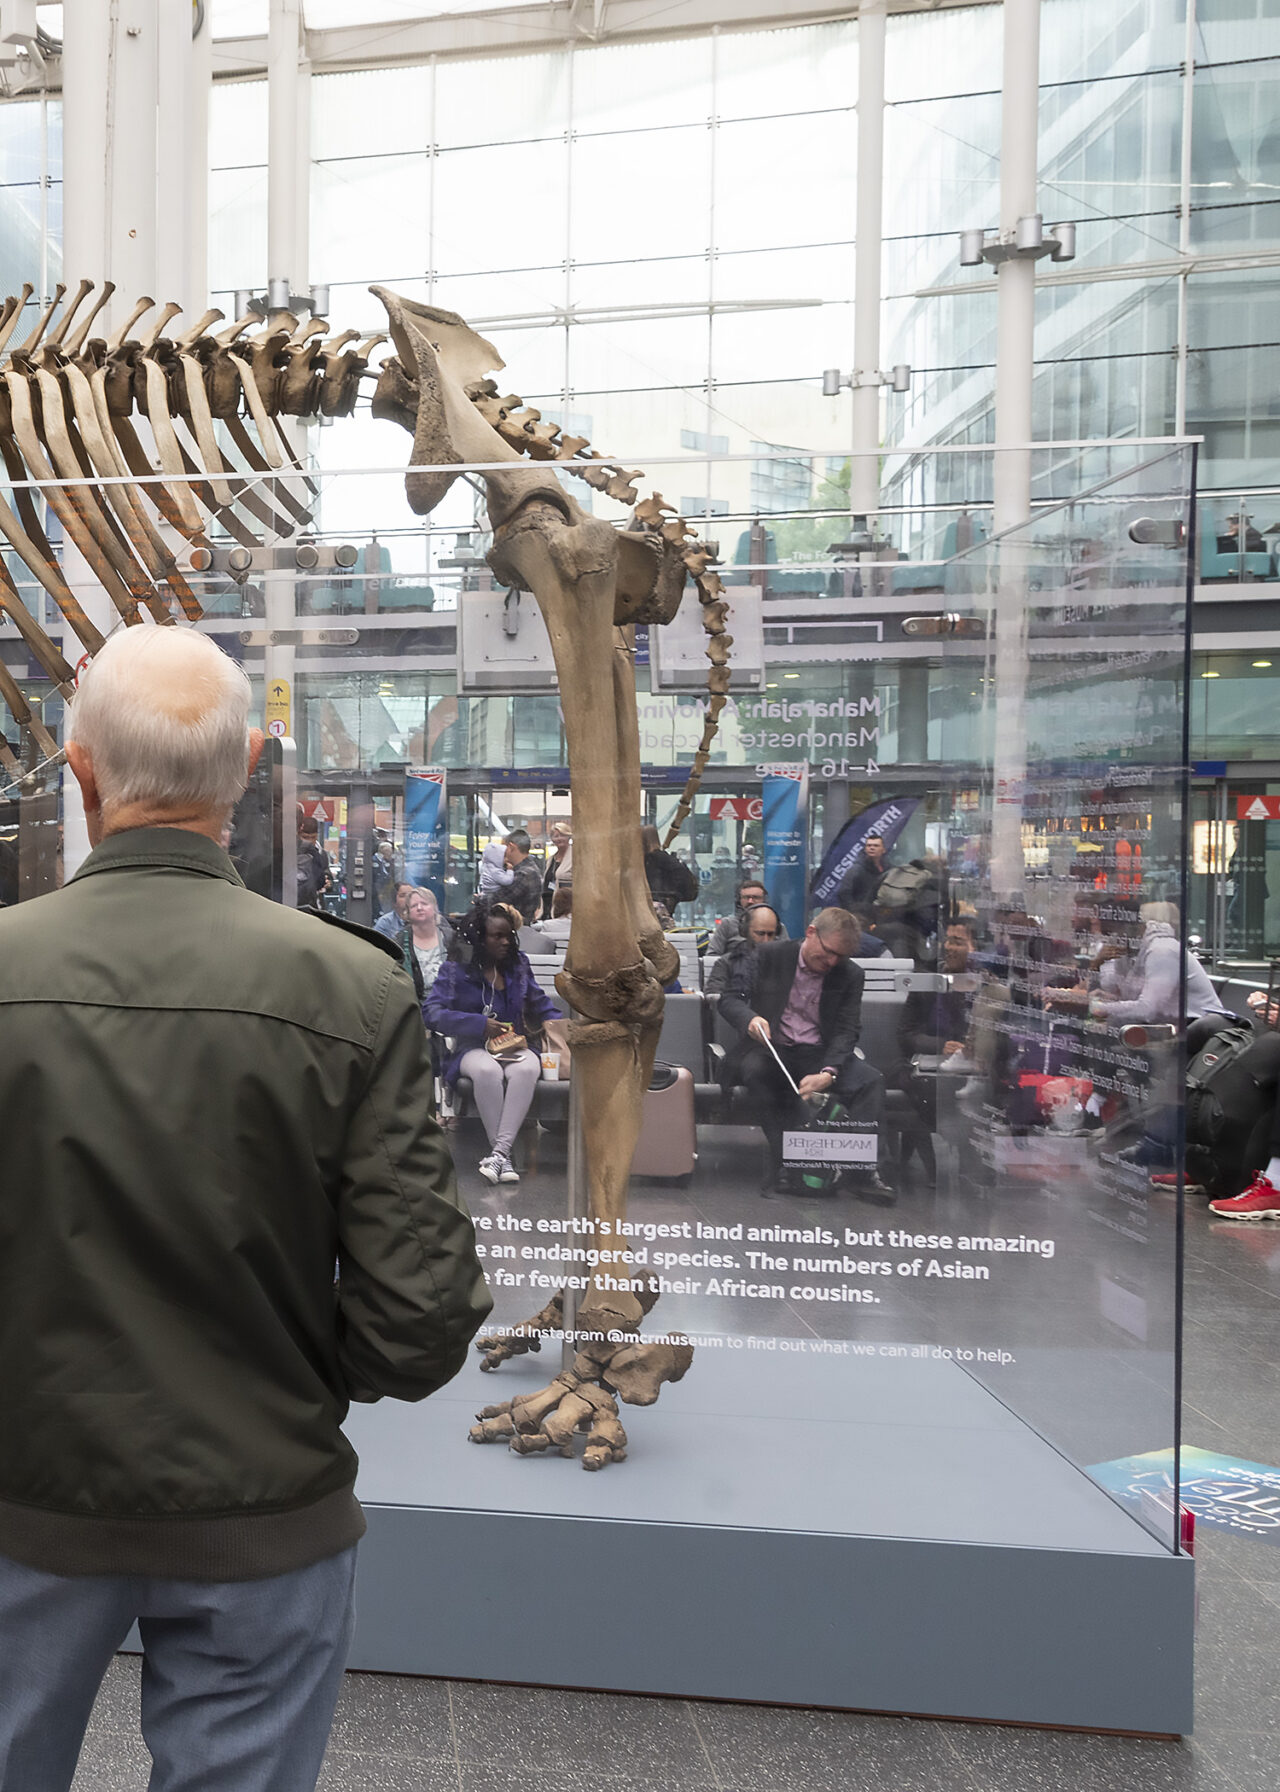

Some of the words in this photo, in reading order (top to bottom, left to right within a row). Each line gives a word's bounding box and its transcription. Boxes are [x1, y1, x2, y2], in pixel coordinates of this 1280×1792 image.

[471, 1216, 492, 1230] re
[496, 1214, 532, 1231] the
[616, 1218, 692, 1241] largest
[696, 1222, 743, 1240] land
[747, 1225, 840, 1247] animals,
[845, 1228, 885, 1247] but
[888, 1230, 953, 1249] these
[957, 1235, 1055, 1258] amazing
[491, 1245, 516, 1258] an
[521, 1243, 648, 1267] endangered
[652, 1250, 741, 1270] species.
[745, 1251, 789, 1271] The
[793, 1256, 893, 1276] numbers
[897, 1258, 923, 1277] of
[925, 1260, 990, 1280] Asian
[494, 1268, 525, 1287] far
[529, 1270, 590, 1289] fewer
[594, 1273, 644, 1292] than
[648, 1276, 702, 1294] their
[705, 1278, 785, 1299] African
[789, 1284, 881, 1303] cousins.
[497, 1325, 525, 1338] and
[528, 1325, 605, 1343] Instagram
[607, 1329, 723, 1347] @mcrmuseum
[726, 1335, 744, 1349] to
[747, 1336, 776, 1350] find
[779, 1338, 806, 1353] out
[810, 1340, 849, 1355] what
[852, 1344, 875, 1356] we
[879, 1346, 908, 1358] can
[911, 1345, 928, 1358] all
[931, 1345, 952, 1360] do
[956, 1347, 974, 1361] to
[977, 1348, 1017, 1365] help.
